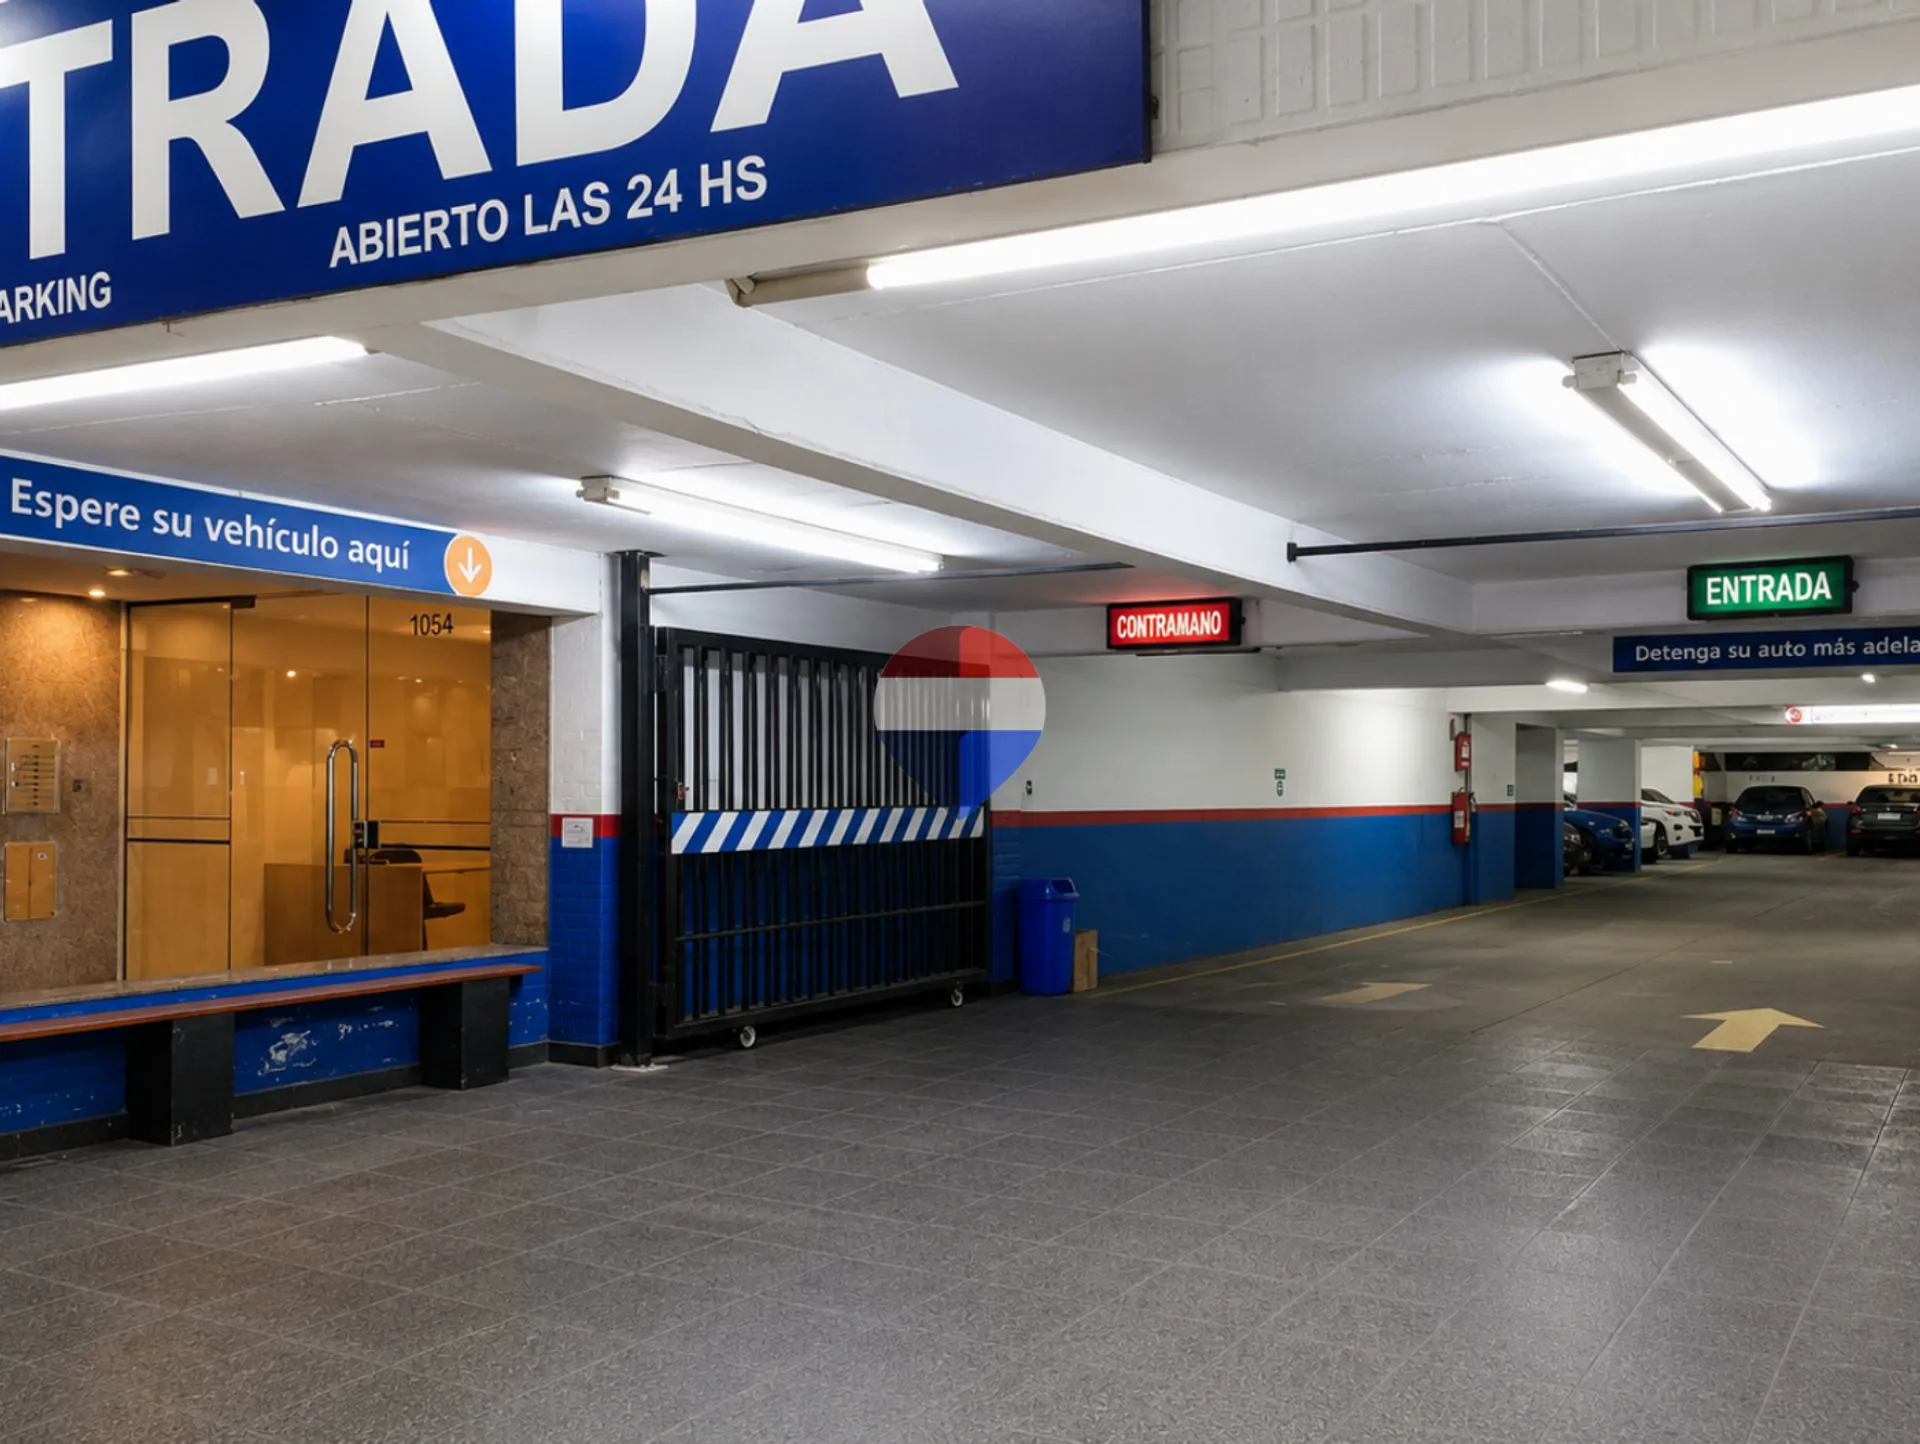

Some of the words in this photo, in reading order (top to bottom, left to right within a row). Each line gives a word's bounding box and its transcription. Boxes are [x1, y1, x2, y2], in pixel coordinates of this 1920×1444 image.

[329, 199, 509, 268] ABIERTO
[524, 181, 611, 236] LAS
[626, 168, 682, 220] 24
[700, 155, 768, 208] HS
[11, 477, 141, 529] Espere
[152, 509, 192, 538] su
[204, 514, 339, 559] vehículo
[348, 540, 410, 573] aquí
[1706, 571, 1832, 605] ENTRADA
[410, 612, 454, 636] 1054
[1116, 610, 1222, 639] CONTRAMANO
[1635, 644, 1721, 664] Detenga
[1728, 643, 1751, 659] su
[1758, 640, 1806, 658] auto
[1813, 637, 1855, 656] más
